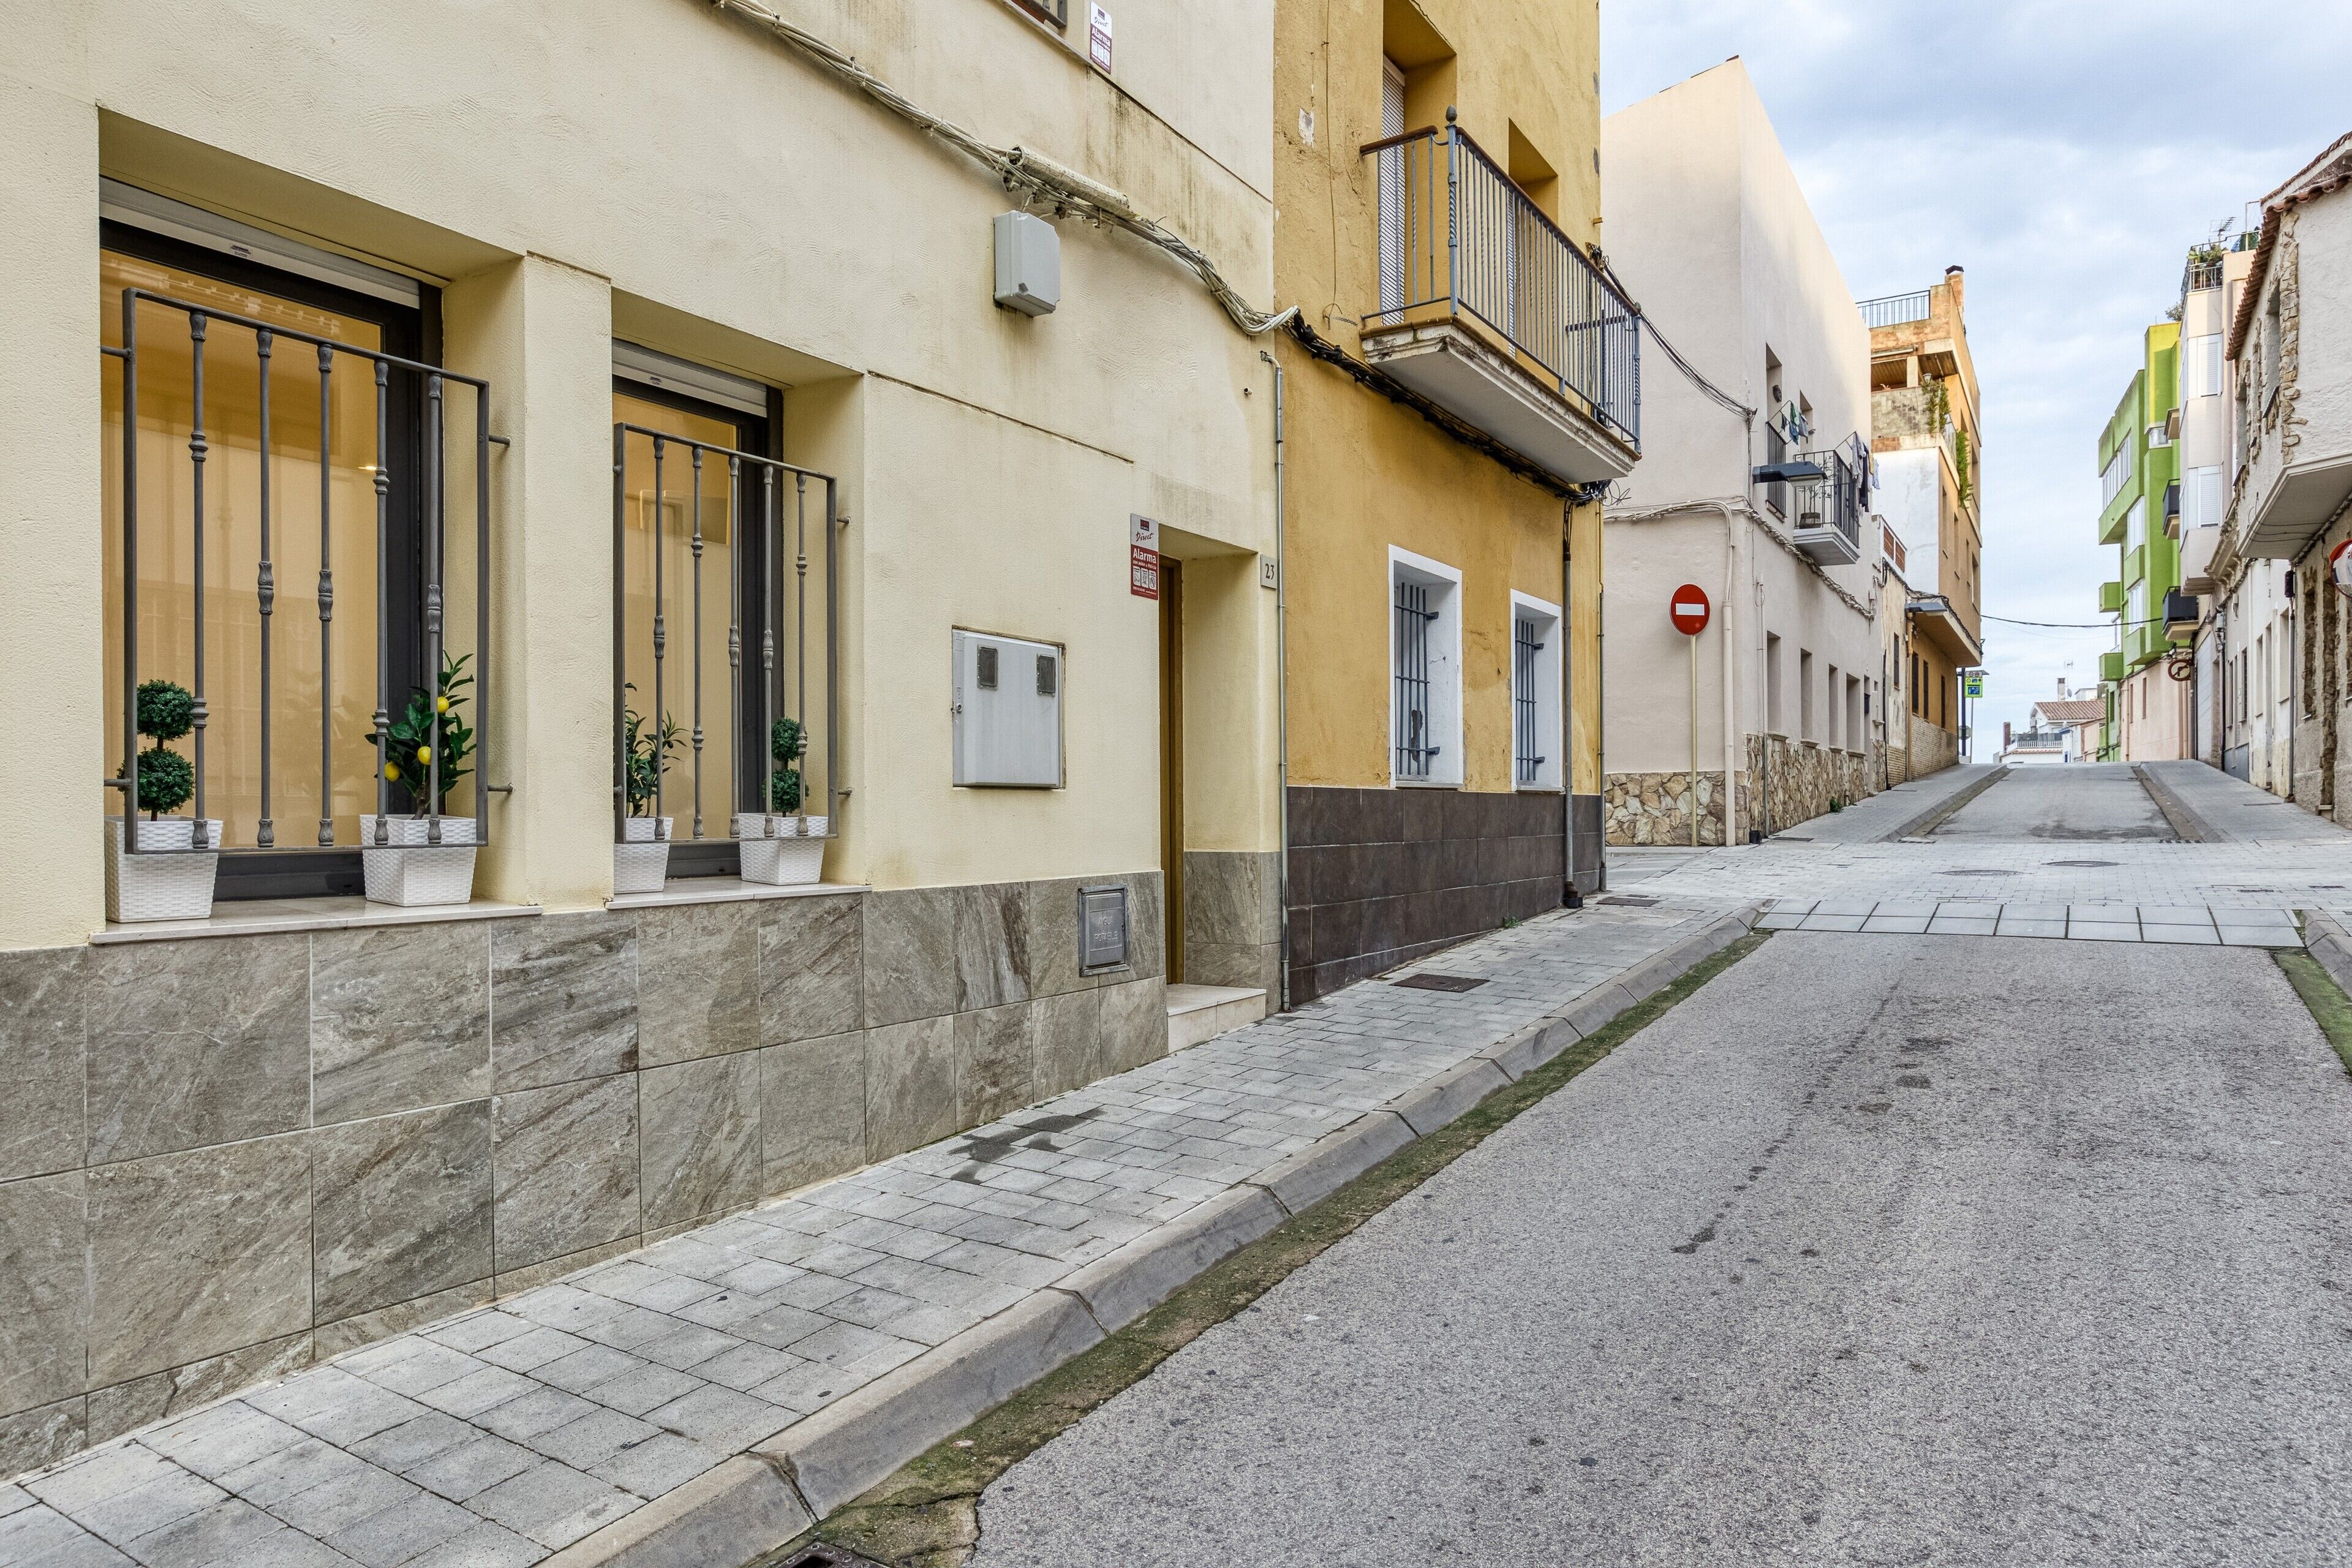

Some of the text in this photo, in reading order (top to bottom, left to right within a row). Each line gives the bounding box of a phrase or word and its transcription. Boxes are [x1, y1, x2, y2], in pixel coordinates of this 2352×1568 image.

[1091, 26, 1110, 47] Alarma
[1136, 531, 1154, 542] Direct
[1133, 548, 1156, 564] Alarma
[1265, 563, 1275, 580] 23
[1094, 931, 1118, 942] POTABLE
